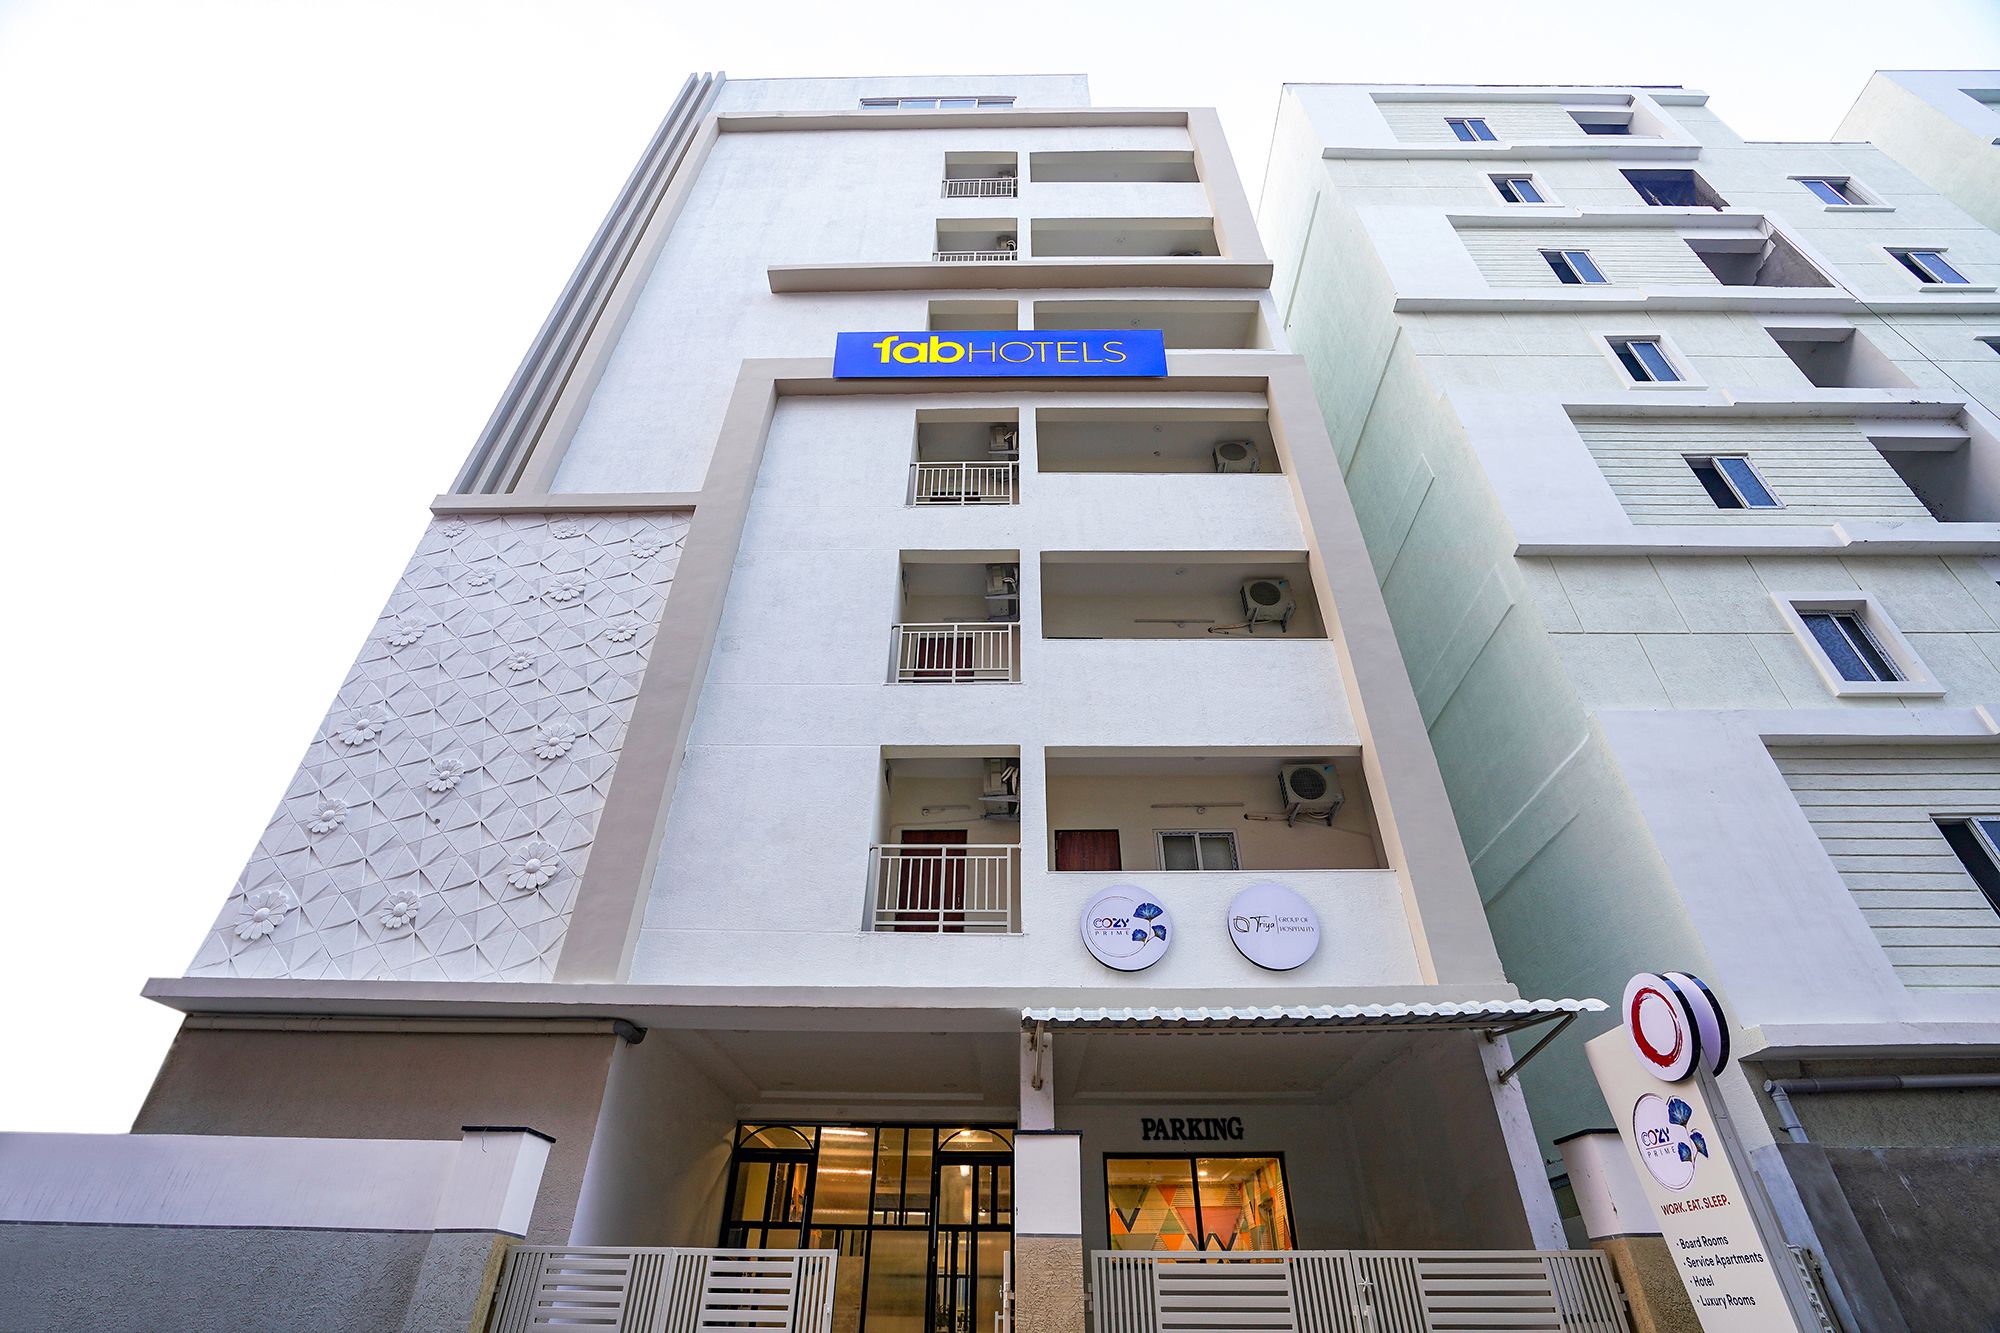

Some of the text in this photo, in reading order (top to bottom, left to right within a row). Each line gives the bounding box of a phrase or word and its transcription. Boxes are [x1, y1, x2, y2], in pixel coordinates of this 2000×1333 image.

[1093, 917, 1129, 928] COZY
[1141, 1117, 1244, 1141] PARKING
[1641, 1126, 1670, 1147] COZY
[1647, 1145, 1676, 1159] PRIME
[1660, 1194, 1731, 1216] WORK. EAT. SLEEP.
[1679, 1235, 1729, 1250] Board Rooms
[1685, 1252, 1764, 1269] Service Apartments
[1692, 1274, 1715, 1287] Hotel
[1699, 1293, 1756, 1309] Luxury Rooms
